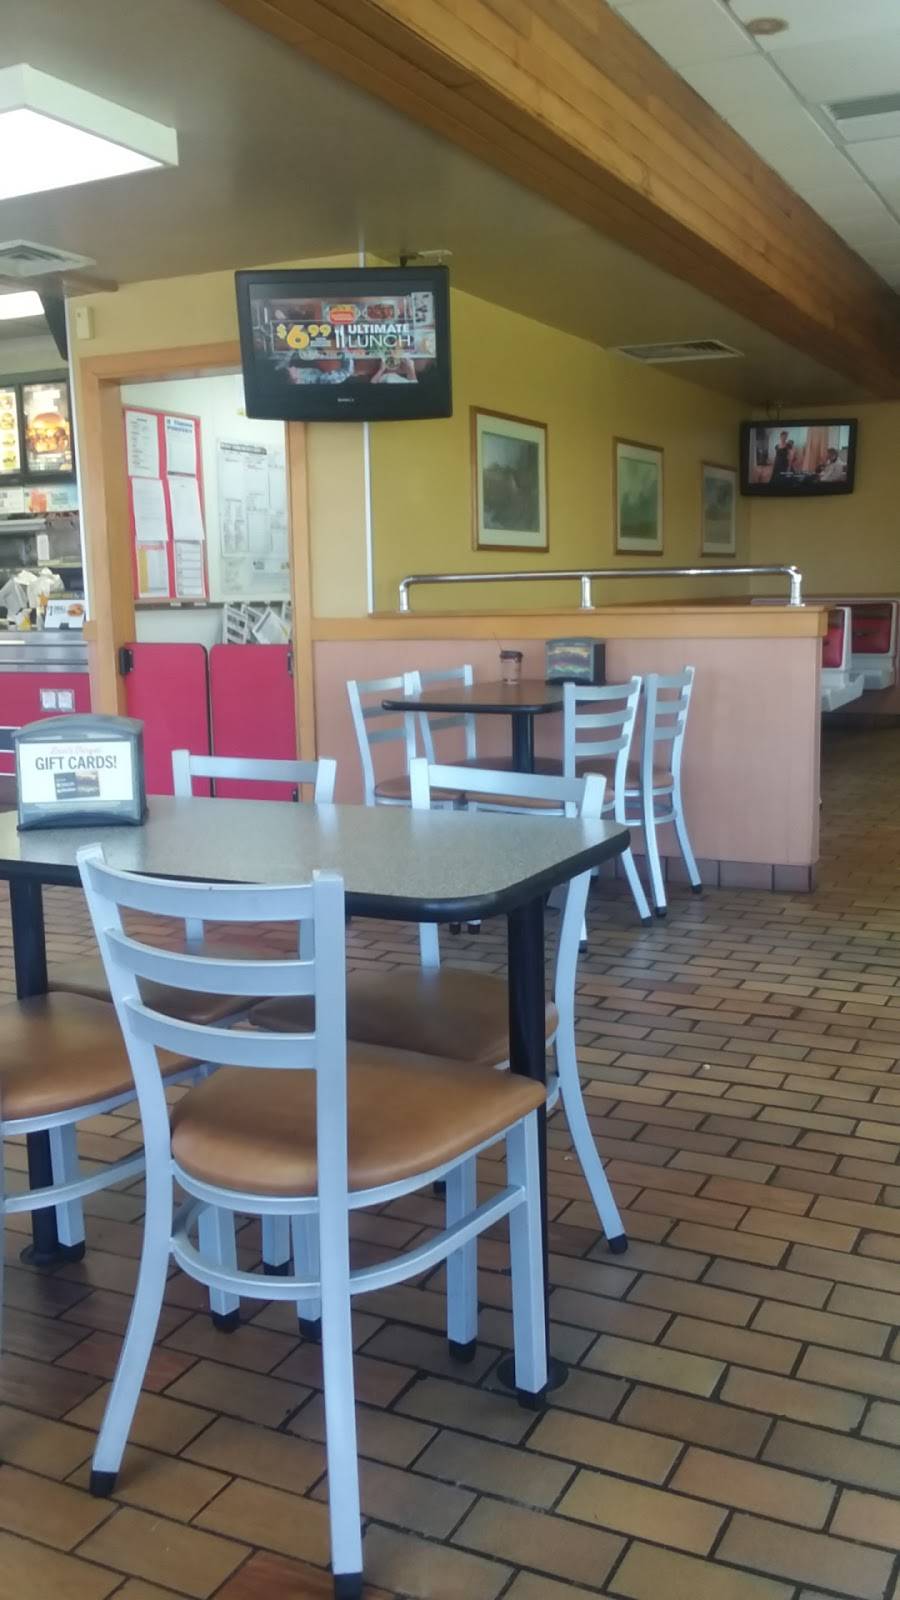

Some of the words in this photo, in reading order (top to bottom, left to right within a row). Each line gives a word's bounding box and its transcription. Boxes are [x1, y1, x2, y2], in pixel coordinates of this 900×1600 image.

[347, 323, 410, 334] ULTIMATE
[348, 334, 411, 348] LUNCH
[35, 756, 65, 771] GIFT
[68, 755, 117, 770] CARDS!
